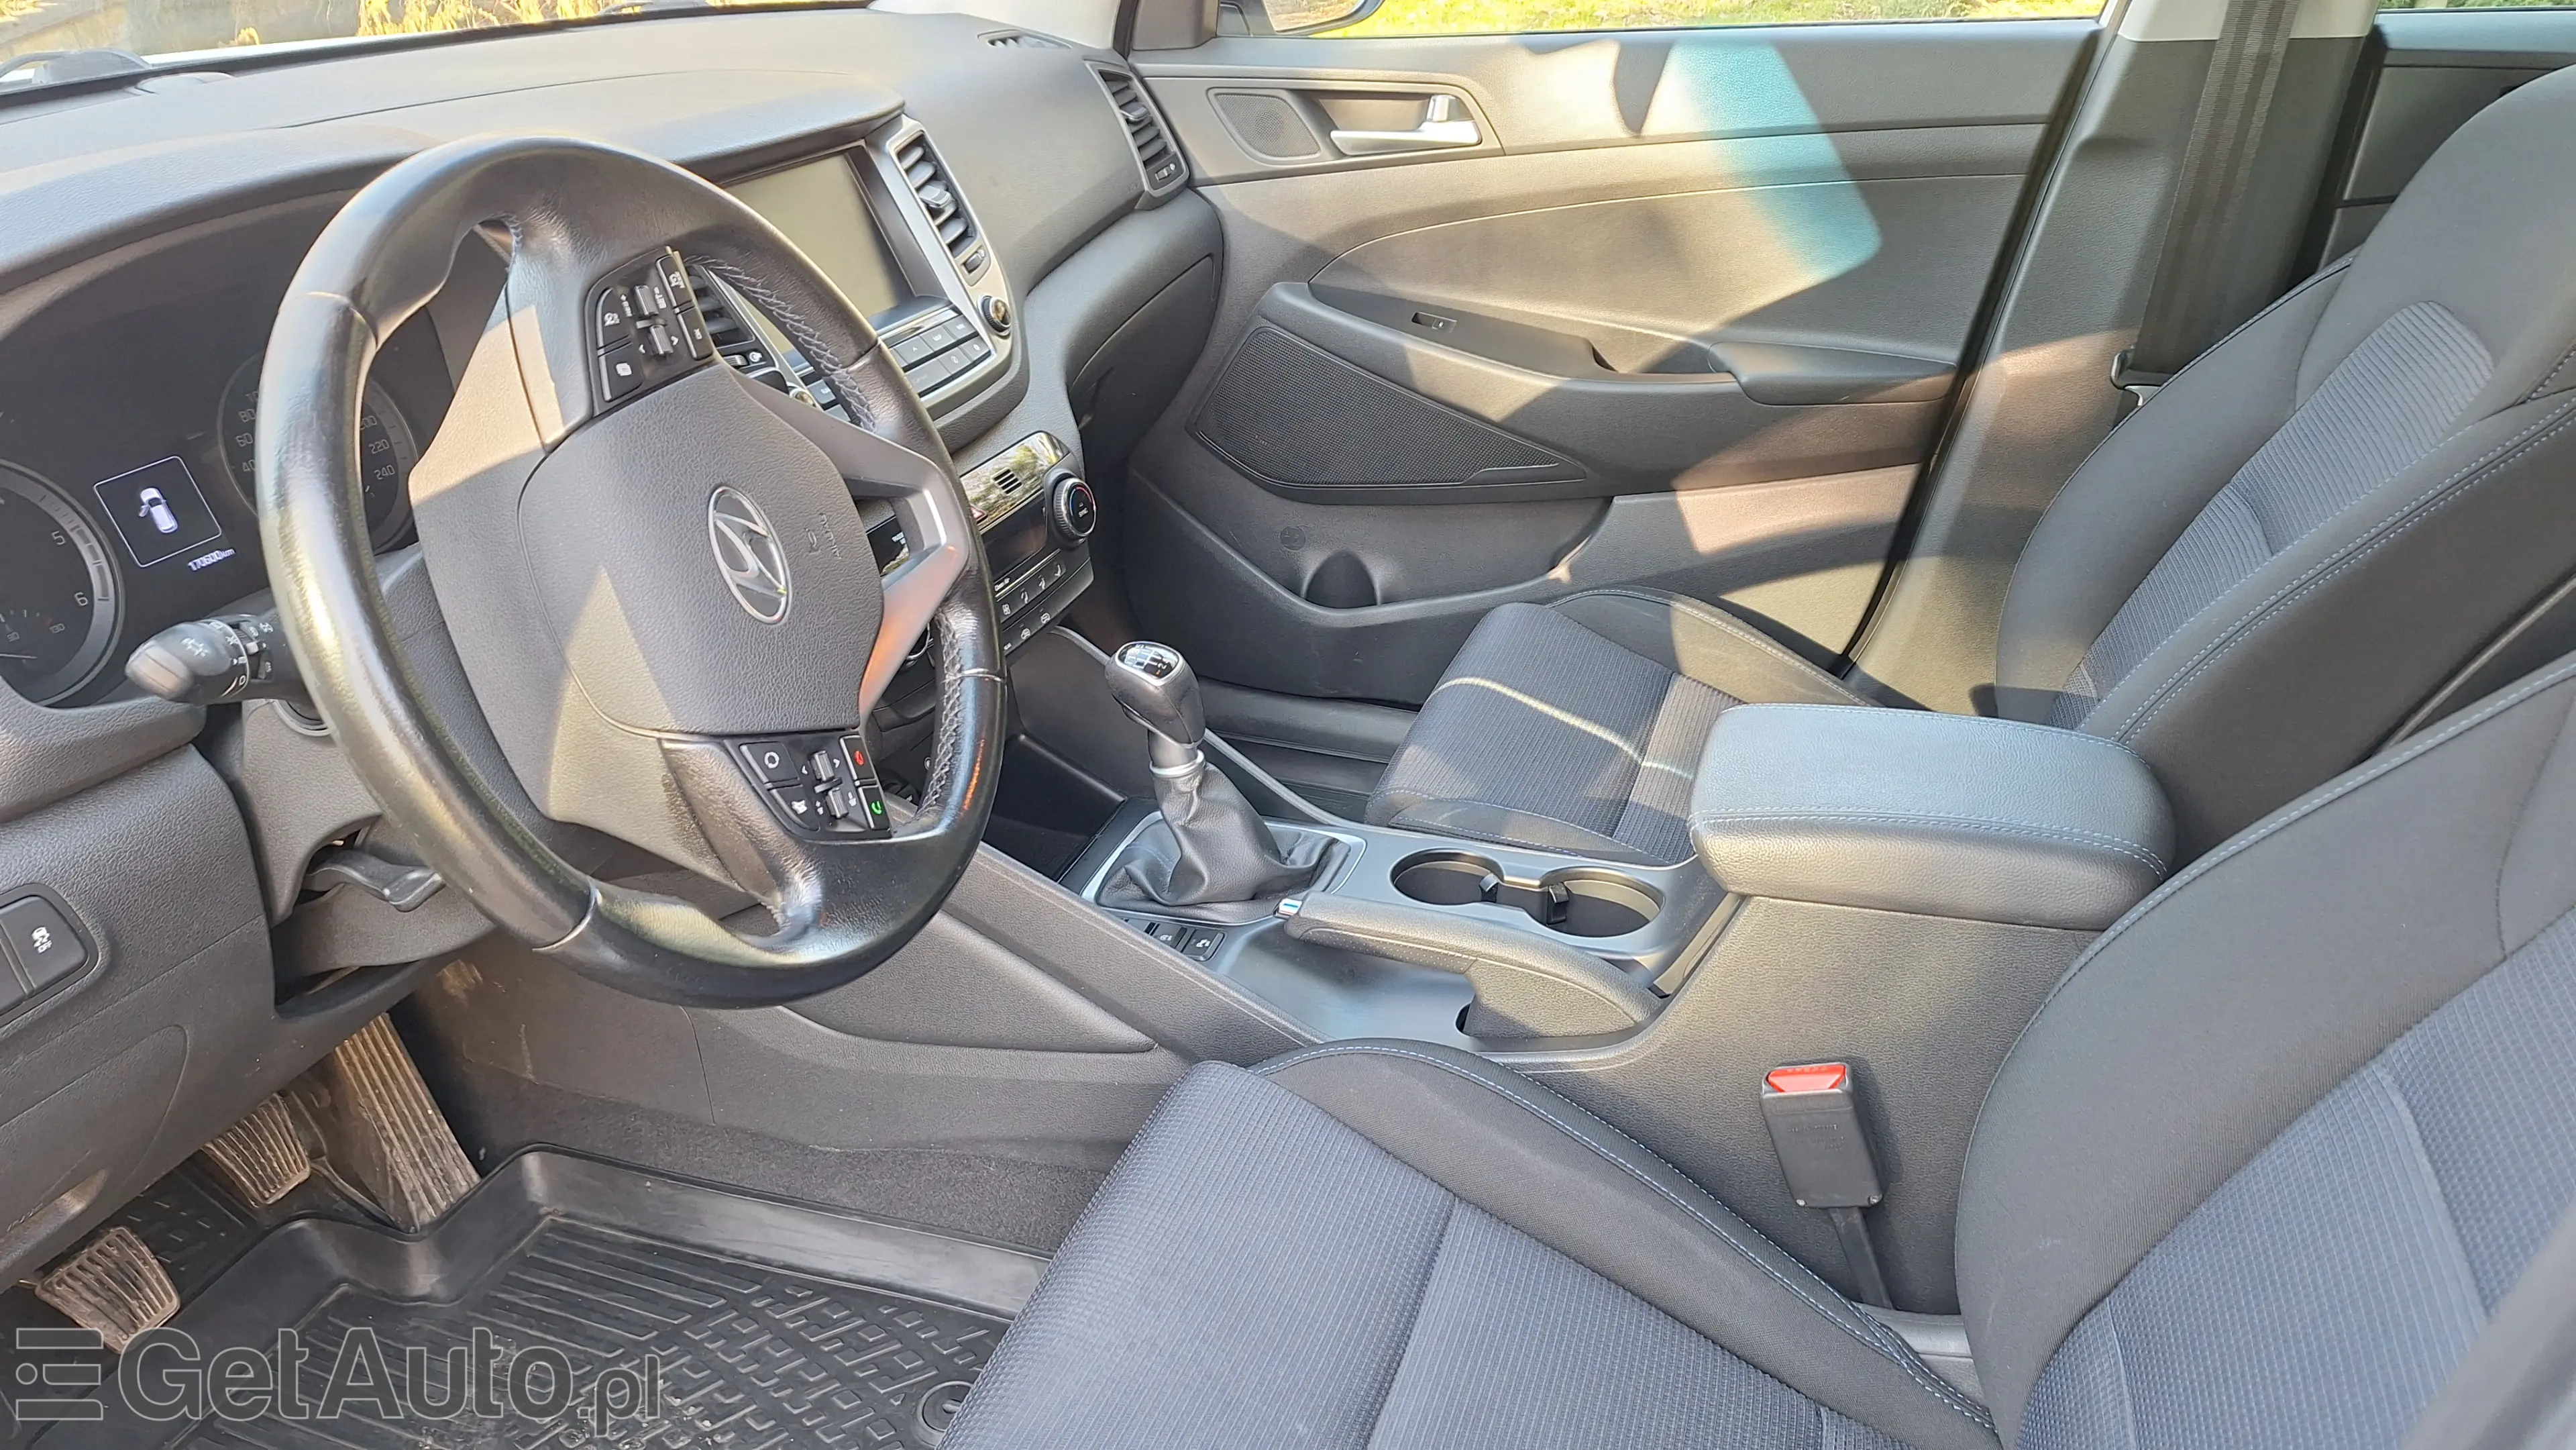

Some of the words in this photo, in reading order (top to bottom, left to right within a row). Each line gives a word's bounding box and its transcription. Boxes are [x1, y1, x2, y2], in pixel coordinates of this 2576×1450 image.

[235, 433, 254, 447] 60
[368, 439, 389, 454] 220
[374, 464, 395, 480] 240
[51, 531, 66, 546] 5
[74, 592, 89, 606] 6
